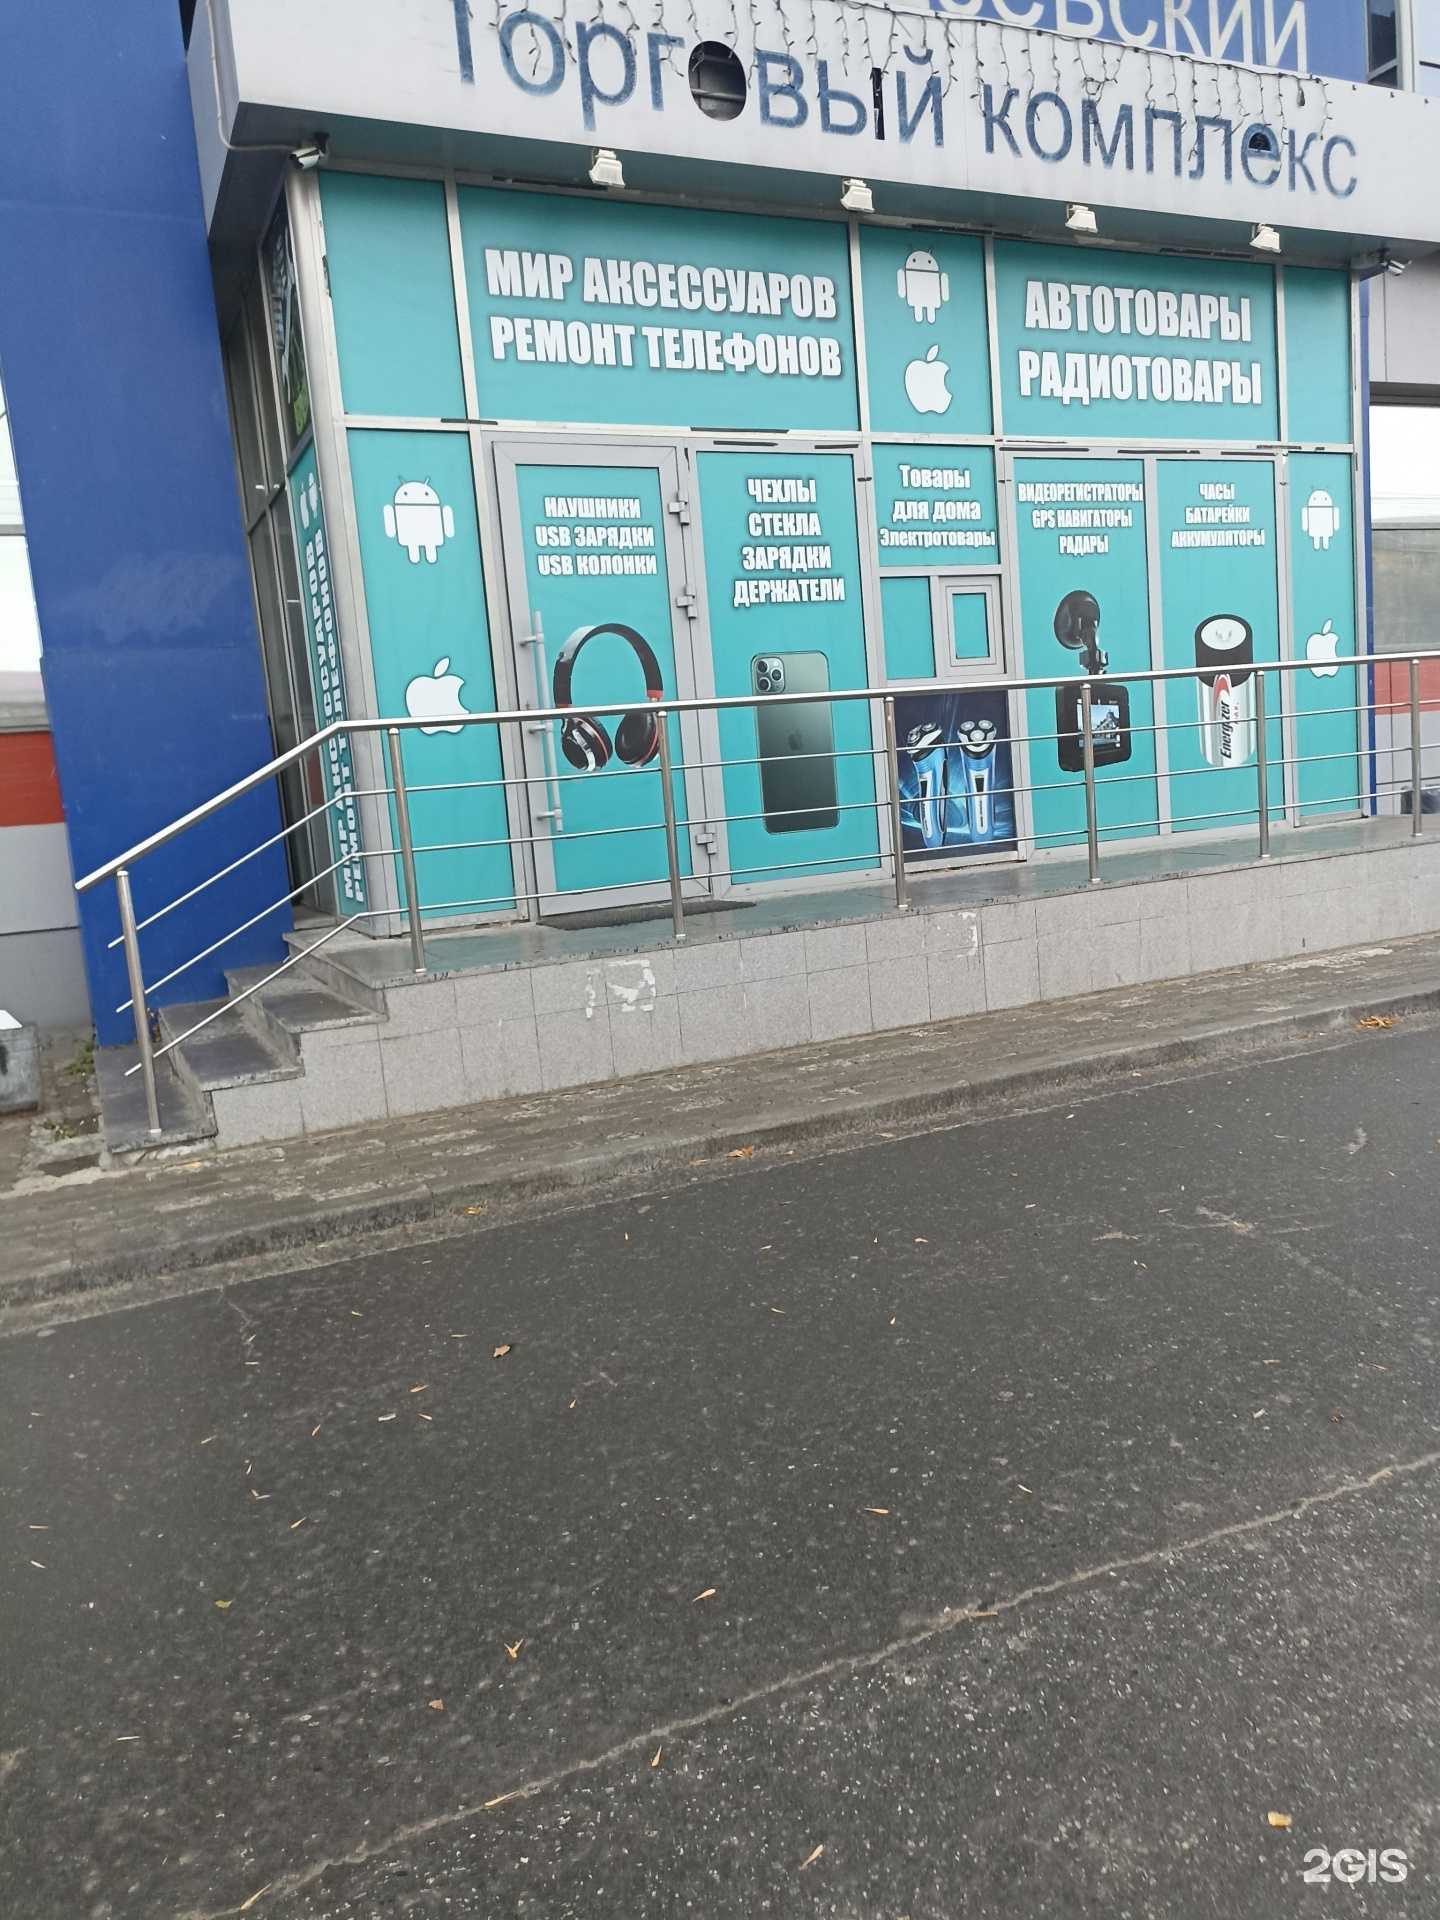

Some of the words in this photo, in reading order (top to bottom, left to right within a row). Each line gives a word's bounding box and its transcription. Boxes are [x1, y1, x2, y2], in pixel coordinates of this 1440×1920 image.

[982, 82, 1358, 198] комплекс
[484, 249, 574, 300] МИР
[584, 257, 837, 319] АКСЕССУАРОВ
[1025, 280, 1252, 342] АВТОТОВАРЫ
[489, 316, 635, 366] РЕМОНТ
[642, 326, 842, 377] ТЕЛЕФОНОВ
[1019, 350, 1262, 405] РАДИОТОВАРЫ
[899, 464, 971, 490] Товары
[747, 478, 817, 503] ЧЕХЛЫ
[1018, 483, 1144, 504] ВИДЕОРЕГИСТРАТОРЫ
[1199, 483, 1235, 500] ЧАСЫ
[544, 496, 641, 519] НАУШНИКИ
[1032, 509, 1056, 528] GPS
[1056, 509, 1133, 528] НАВИГАТОРЫ
[1185, 504, 1250, 523] БАТАРЕЙКИ
[748, 512, 822, 537] СТЕКЛА
[535, 526, 571, 547] USB
[574, 526, 655, 550] ЗАРЯДКИ
[879, 528, 996, 548] Электротовары
[1059, 535, 1109, 556] РАДАРЫ
[537, 554, 574, 576] USB
[576, 554, 658, 576] КОЛОНКИ
[742, 546, 832, 573] ЗАРЯДКИ
[733, 578, 846, 608] ДЕРЖАТЕЛИ
[1220, 700, 1232, 760] Energzer
